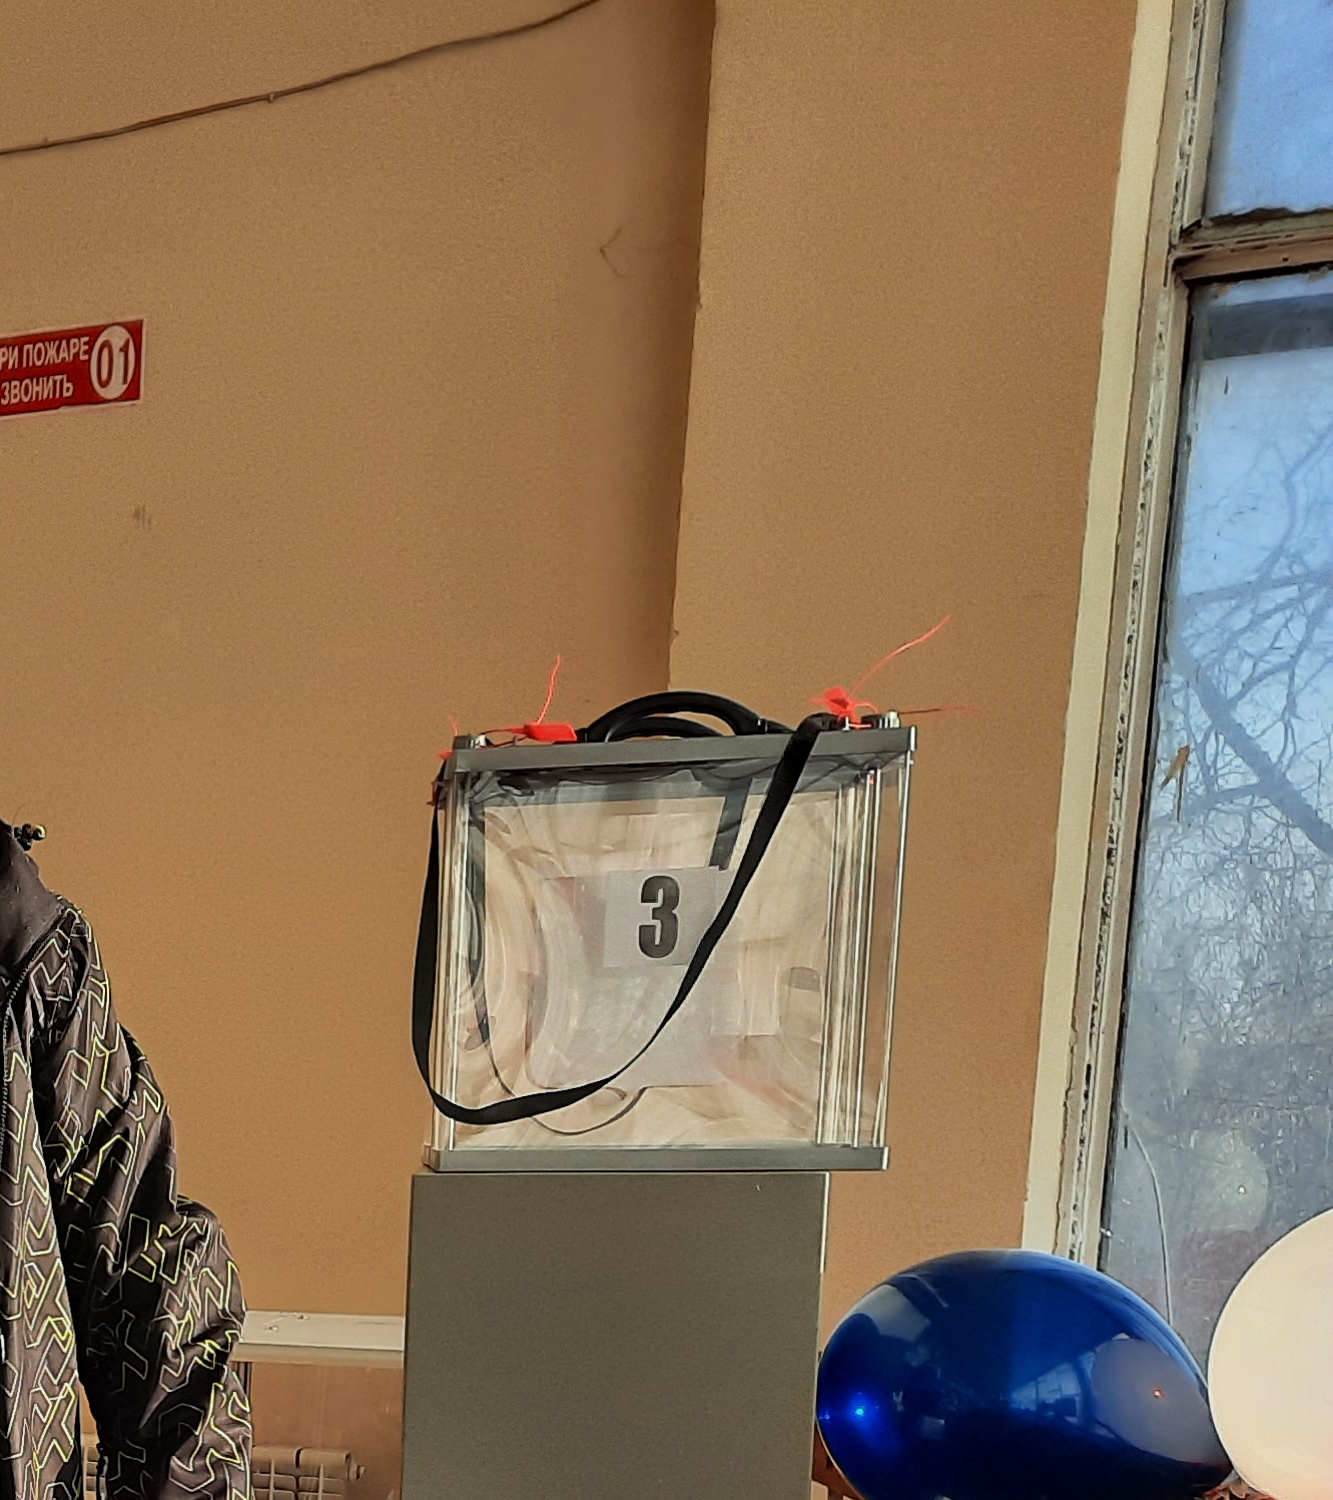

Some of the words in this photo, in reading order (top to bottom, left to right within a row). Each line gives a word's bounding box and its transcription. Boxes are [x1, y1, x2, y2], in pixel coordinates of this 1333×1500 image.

[22, 336, 90, 368] ПОЖАРЕ
[96, 337, 130, 389] 01
[0, 374, 74, 405] ЗВОНИТЬ
[637, 874, 681, 959] 3
